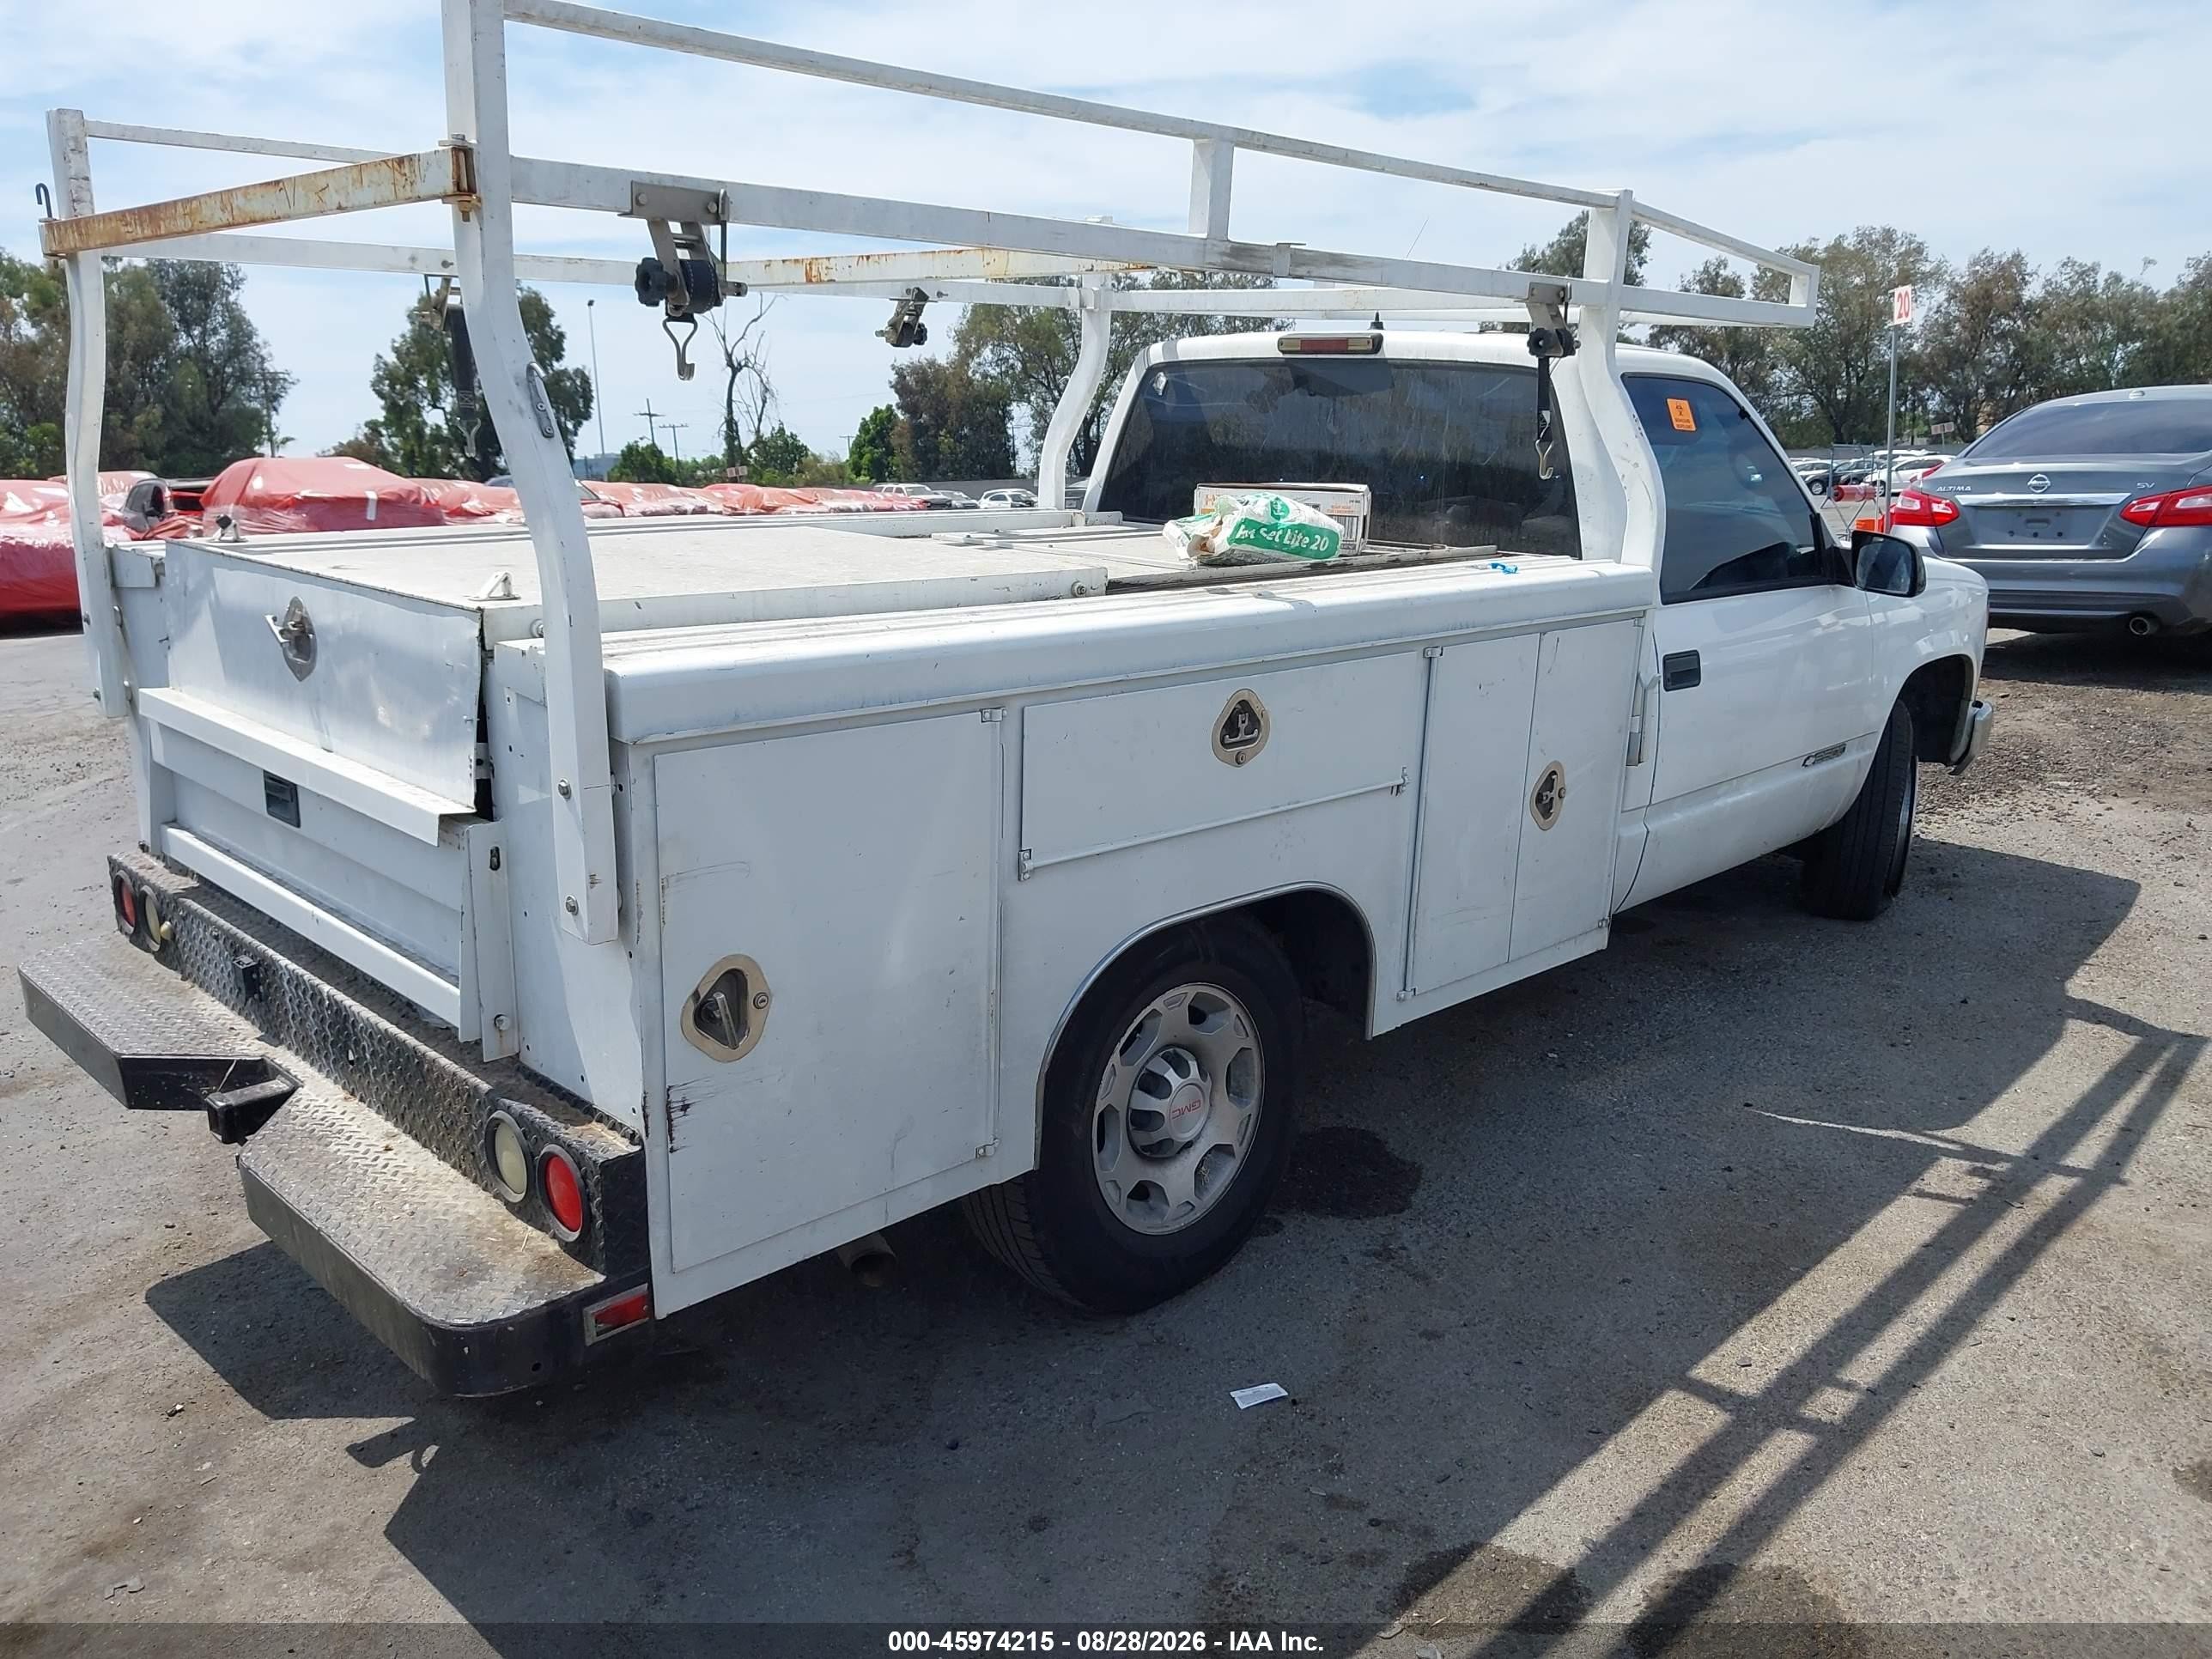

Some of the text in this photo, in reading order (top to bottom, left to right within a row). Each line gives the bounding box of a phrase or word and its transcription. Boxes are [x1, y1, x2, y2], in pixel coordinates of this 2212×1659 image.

[1897, 291, 1910, 319] 20
[1283, 529, 1310, 548] Lite
[1309, 534, 1329, 551] 20
[1171, 1099, 1201, 1119] GMC
